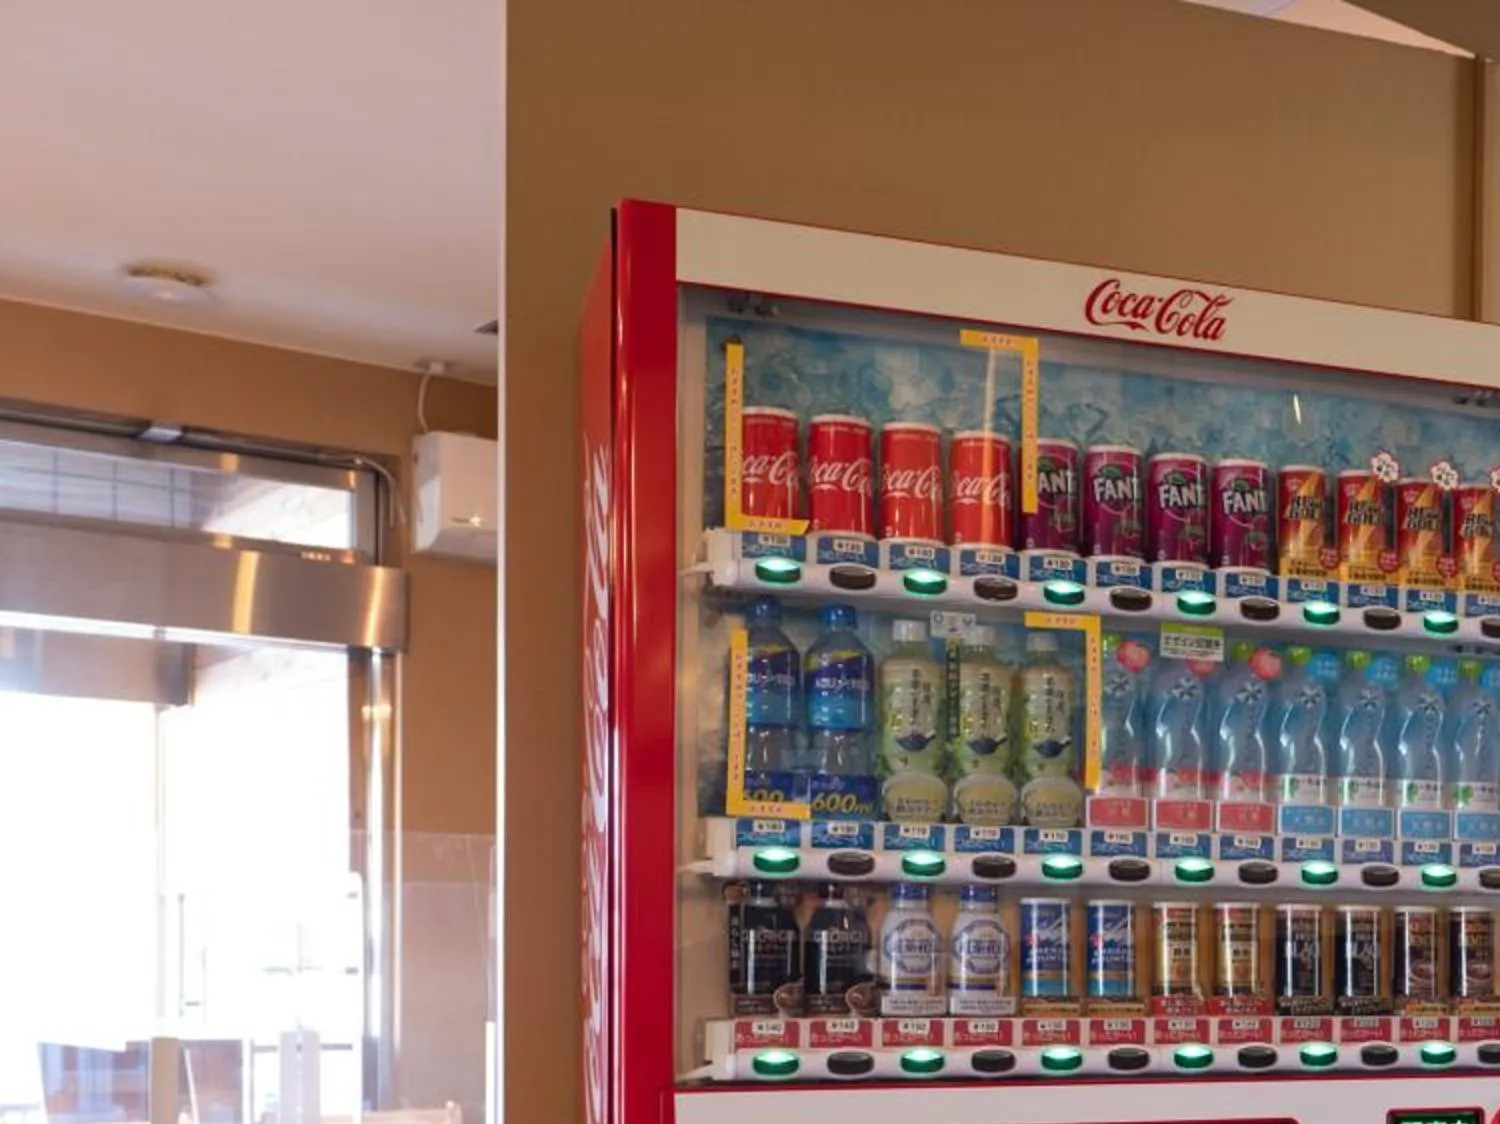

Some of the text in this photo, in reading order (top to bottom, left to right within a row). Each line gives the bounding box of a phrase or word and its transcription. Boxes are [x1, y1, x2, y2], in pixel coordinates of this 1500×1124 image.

[1085, 277, 1232, 342] Coca-Cola
[1093, 476, 1141, 502] FANT
[1159, 482, 1206, 508] FANT
[1222, 489, 1268, 514] FANT
